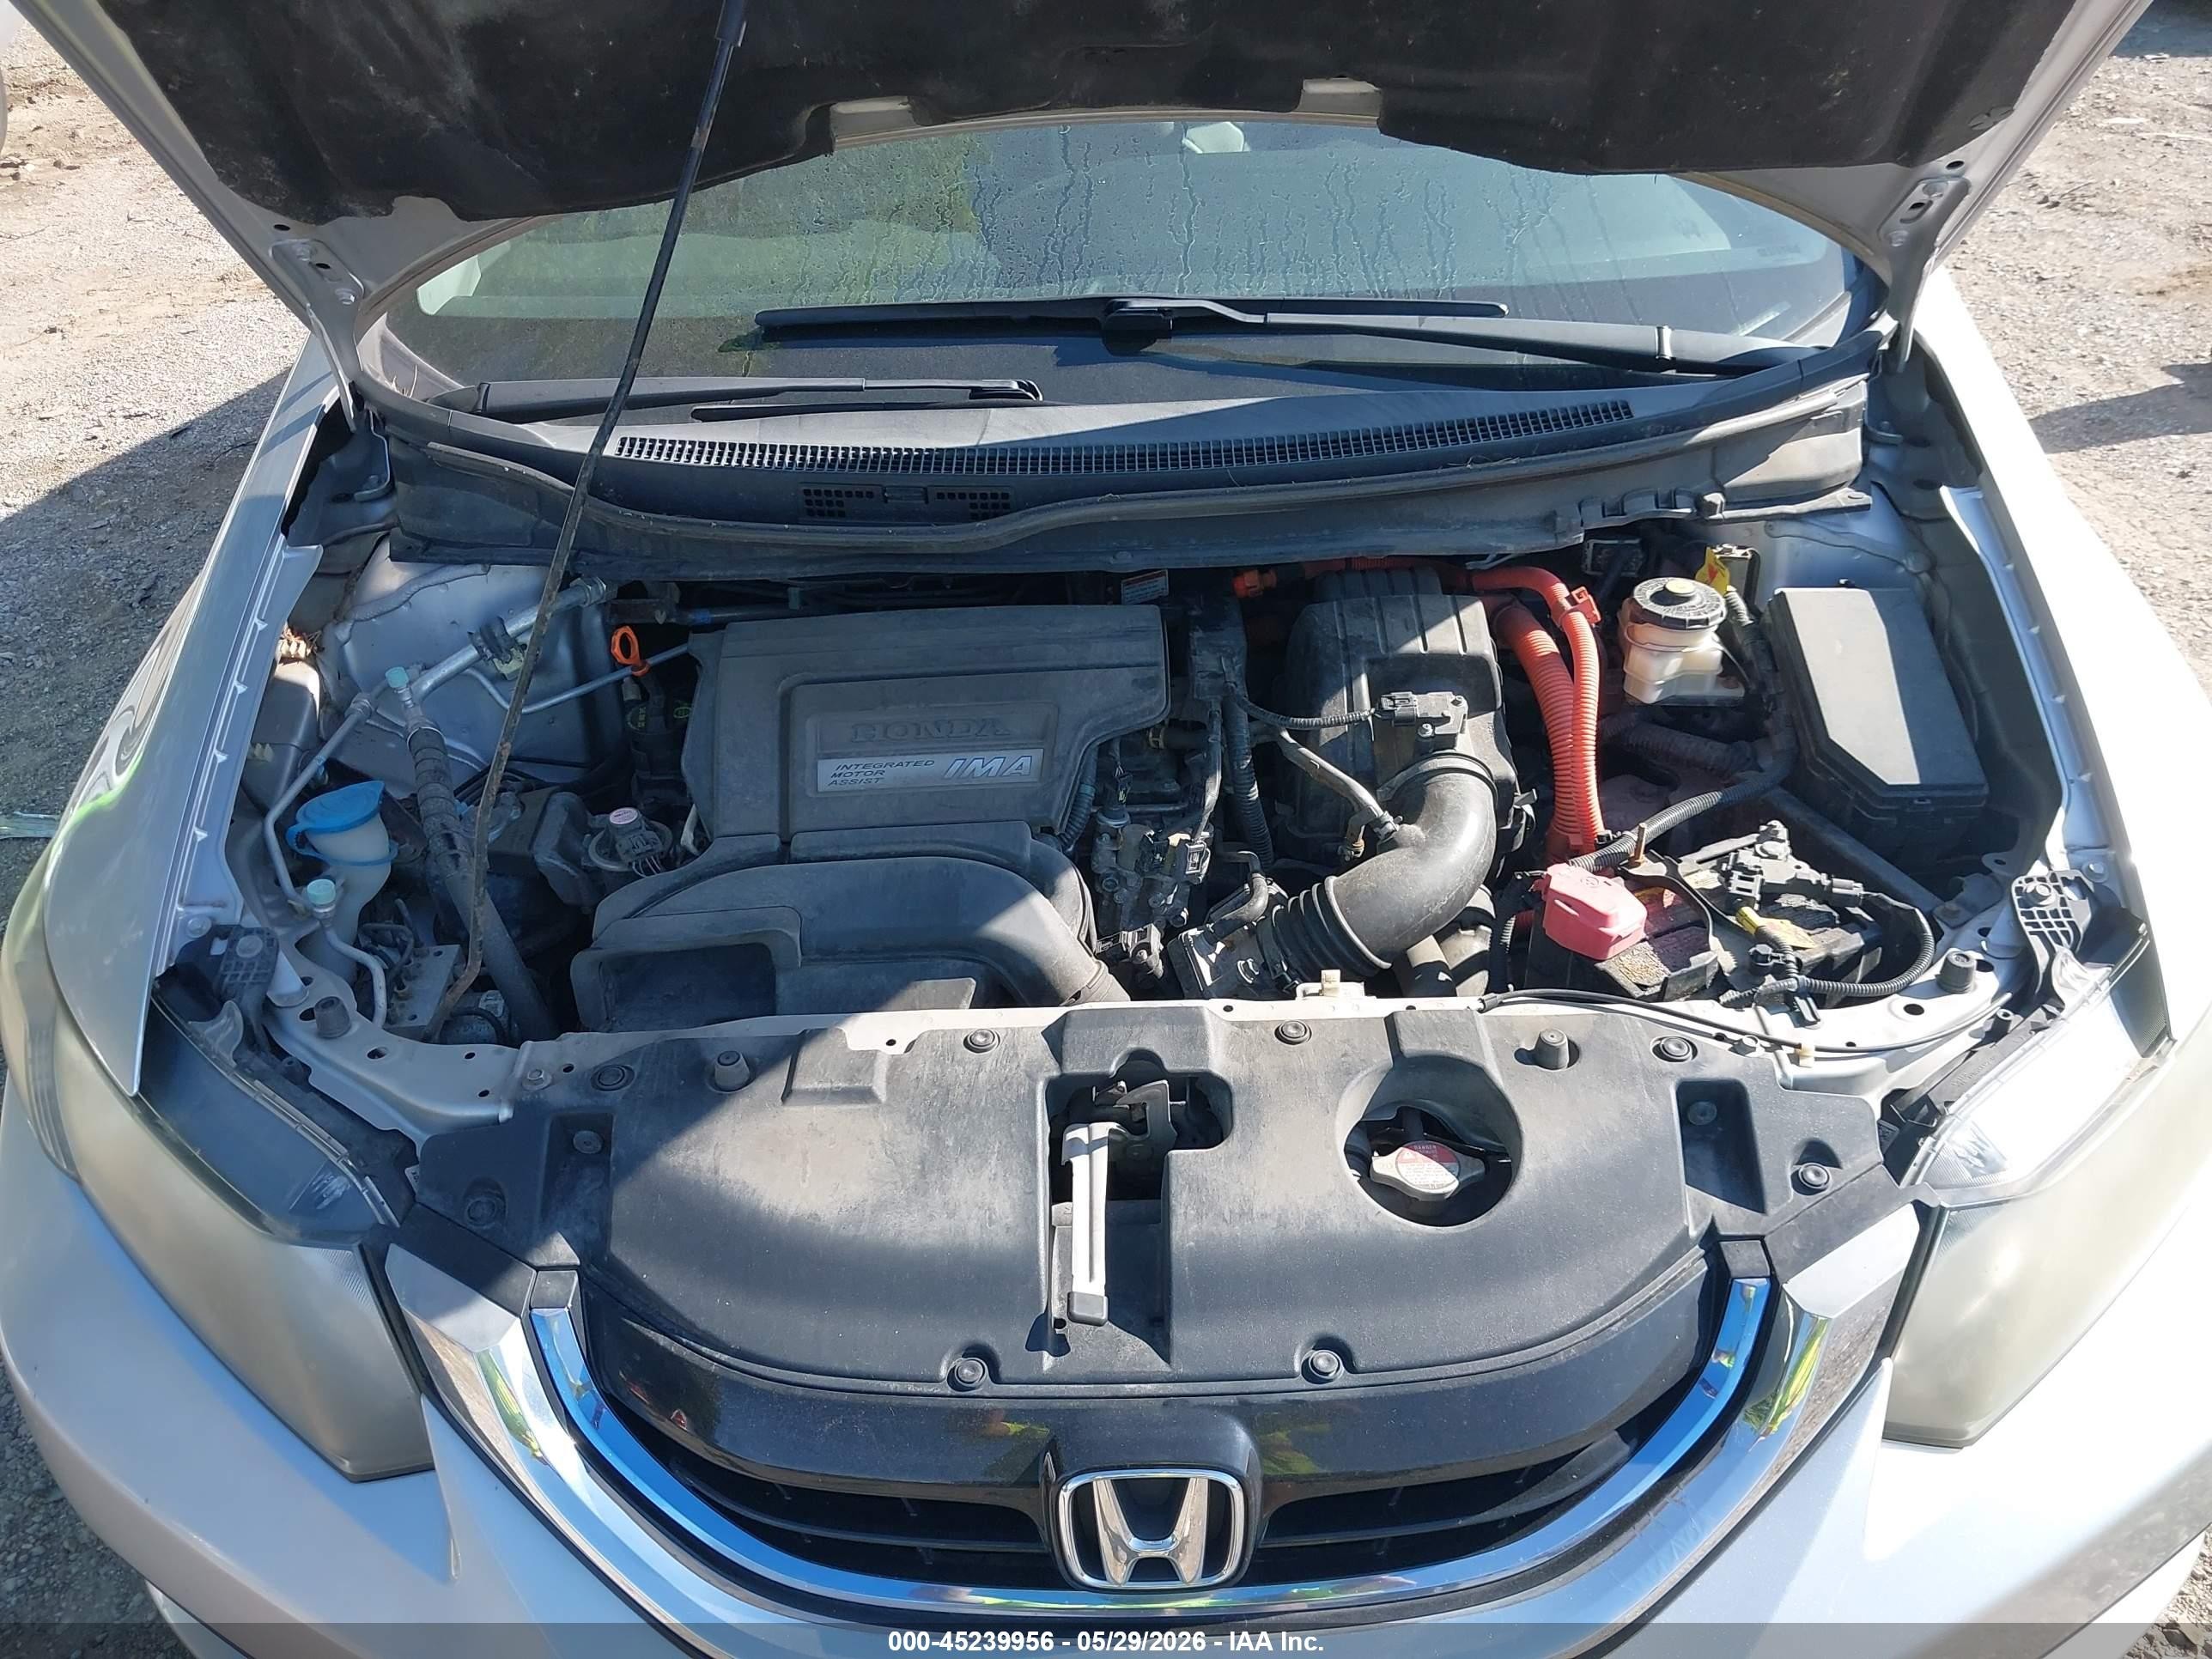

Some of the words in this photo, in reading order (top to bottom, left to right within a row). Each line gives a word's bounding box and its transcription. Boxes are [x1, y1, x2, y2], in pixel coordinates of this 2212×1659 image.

[851, 718, 1012, 743] HONDA
[836, 759, 935, 771] INTEGRATED
[943, 756, 1033, 780] IMA
[830, 769, 886, 779] MOTOR
[828, 777, 884, 787] ASSIST
